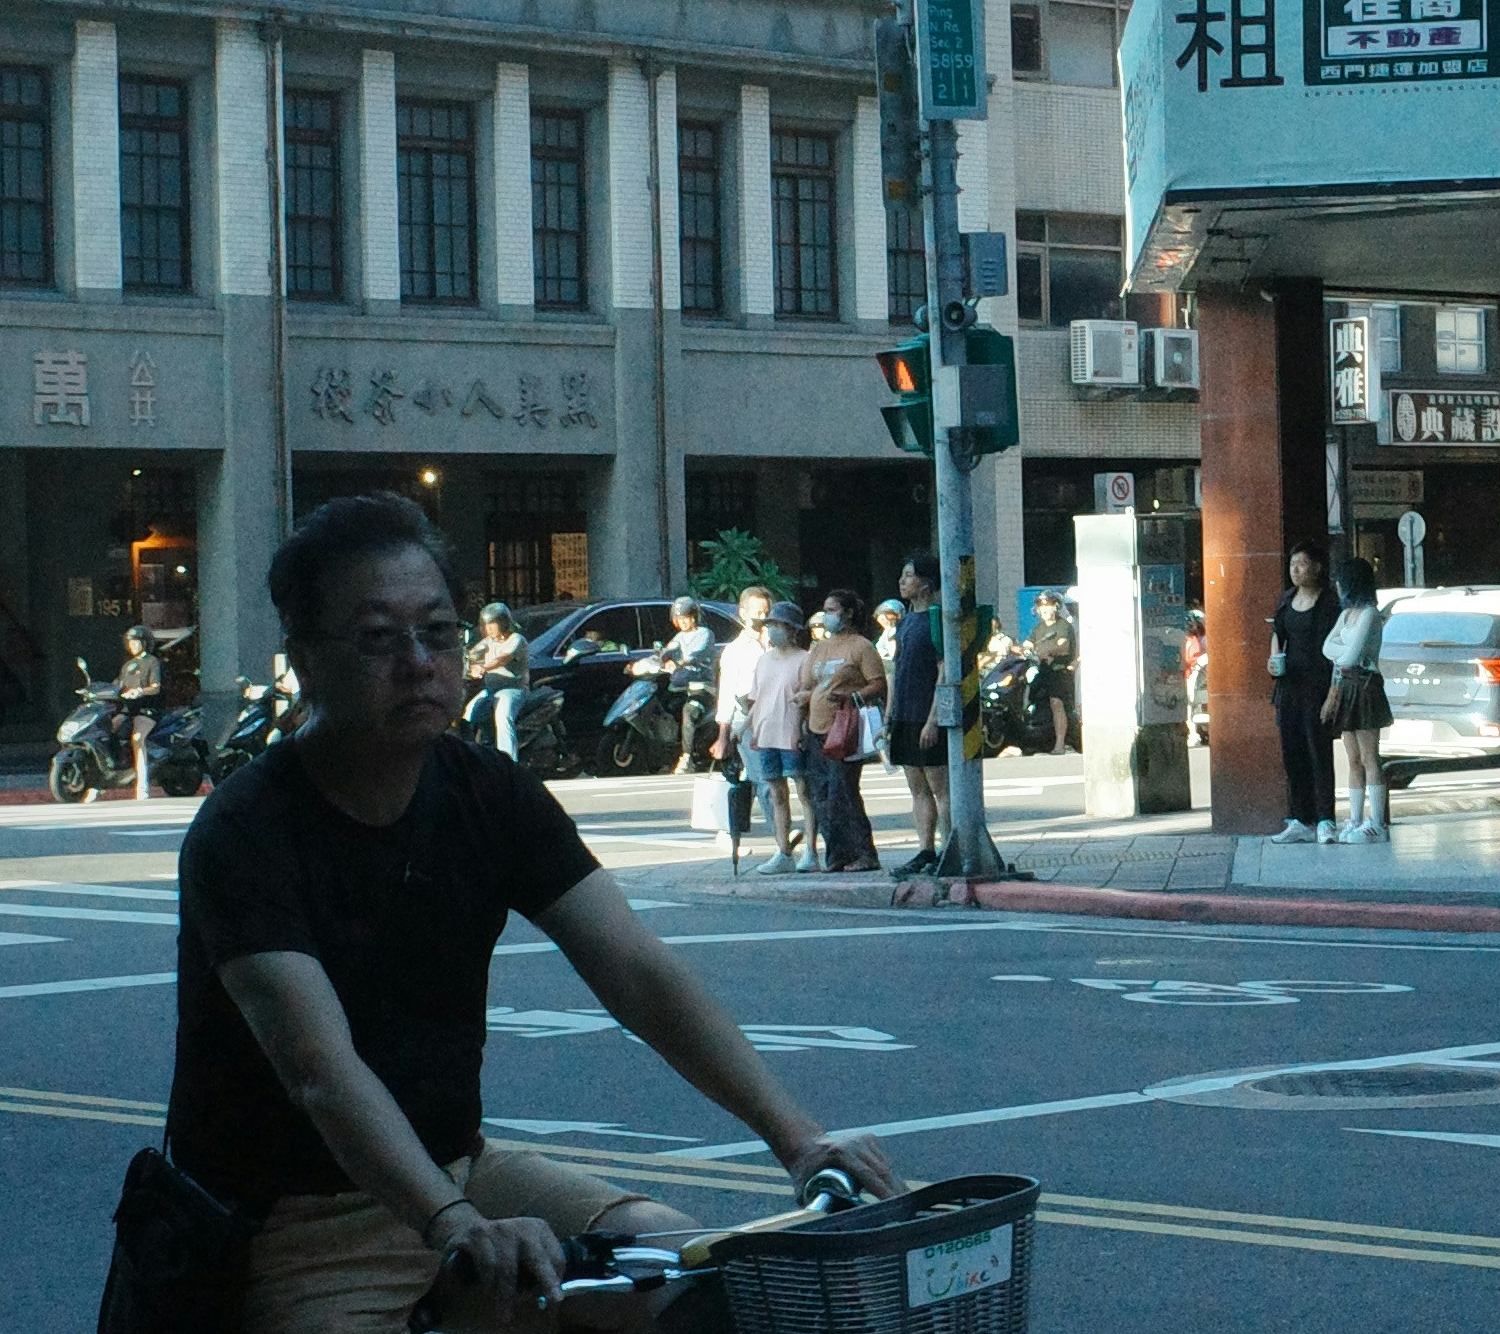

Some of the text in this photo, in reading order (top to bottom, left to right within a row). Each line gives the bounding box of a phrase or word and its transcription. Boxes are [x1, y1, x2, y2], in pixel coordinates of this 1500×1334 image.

[1346, 26, 1462, 50] 不動產
[953, 53, 974, 69] 59
[1320, 58, 1489, 80] 西門捷運加盟店
[1335, 323, 1365, 408] 典雅
[129, 350, 157, 428] 公共
